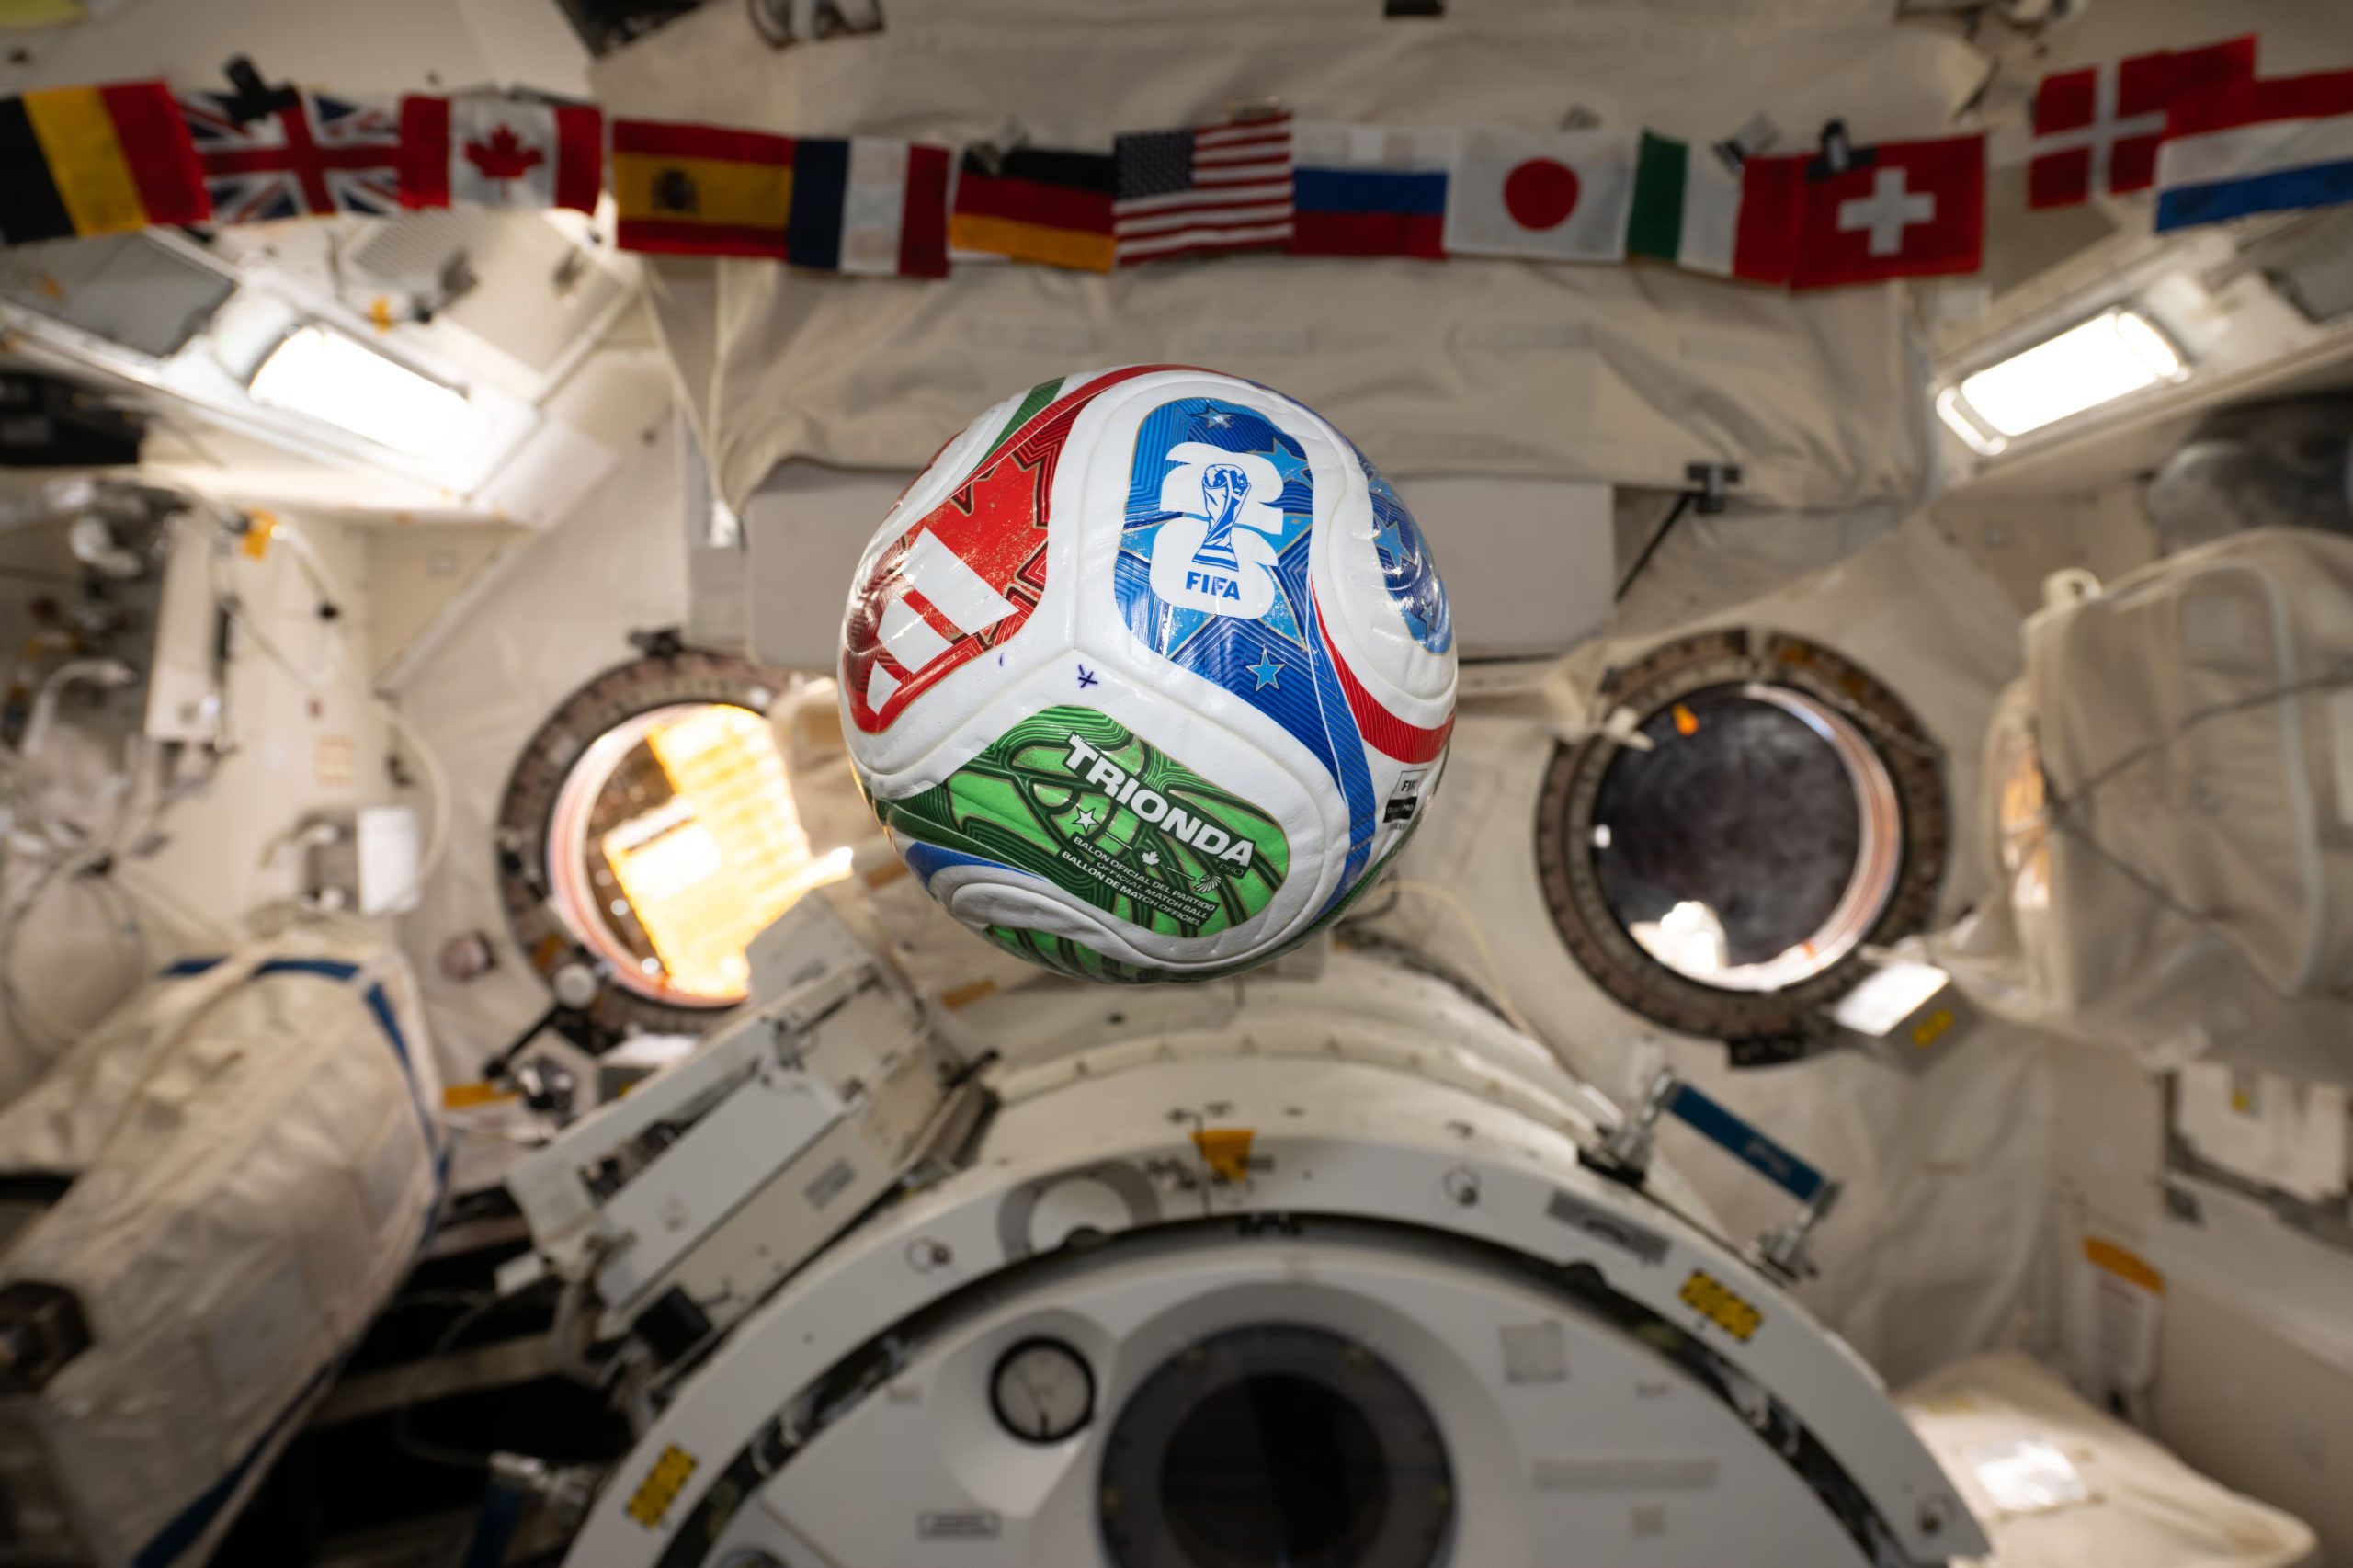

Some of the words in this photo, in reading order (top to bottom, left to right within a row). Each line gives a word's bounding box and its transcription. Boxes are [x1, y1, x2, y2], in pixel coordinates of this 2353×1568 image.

[1186, 571, 1241, 601] FIFA
[1064, 734, 1253, 867] TRIONDA
[1062, 851, 1106, 881] BALLON
[1105, 877, 1120, 889] DE
[1120, 885, 1159, 906] MATCH
[1158, 904, 1200, 926] OFFICIEL
[1074, 836, 1111, 862] BALON
[1110, 859, 1151, 885] OFICIAL
[1152, 881, 1171, 893] DEL
[1172, 891, 1215, 911] PARTIDO
[1097, 862, 1142, 891] OFFICIAL
[1144, 889, 1181, 908] MATCH
[1182, 904, 1207, 919] BALL
